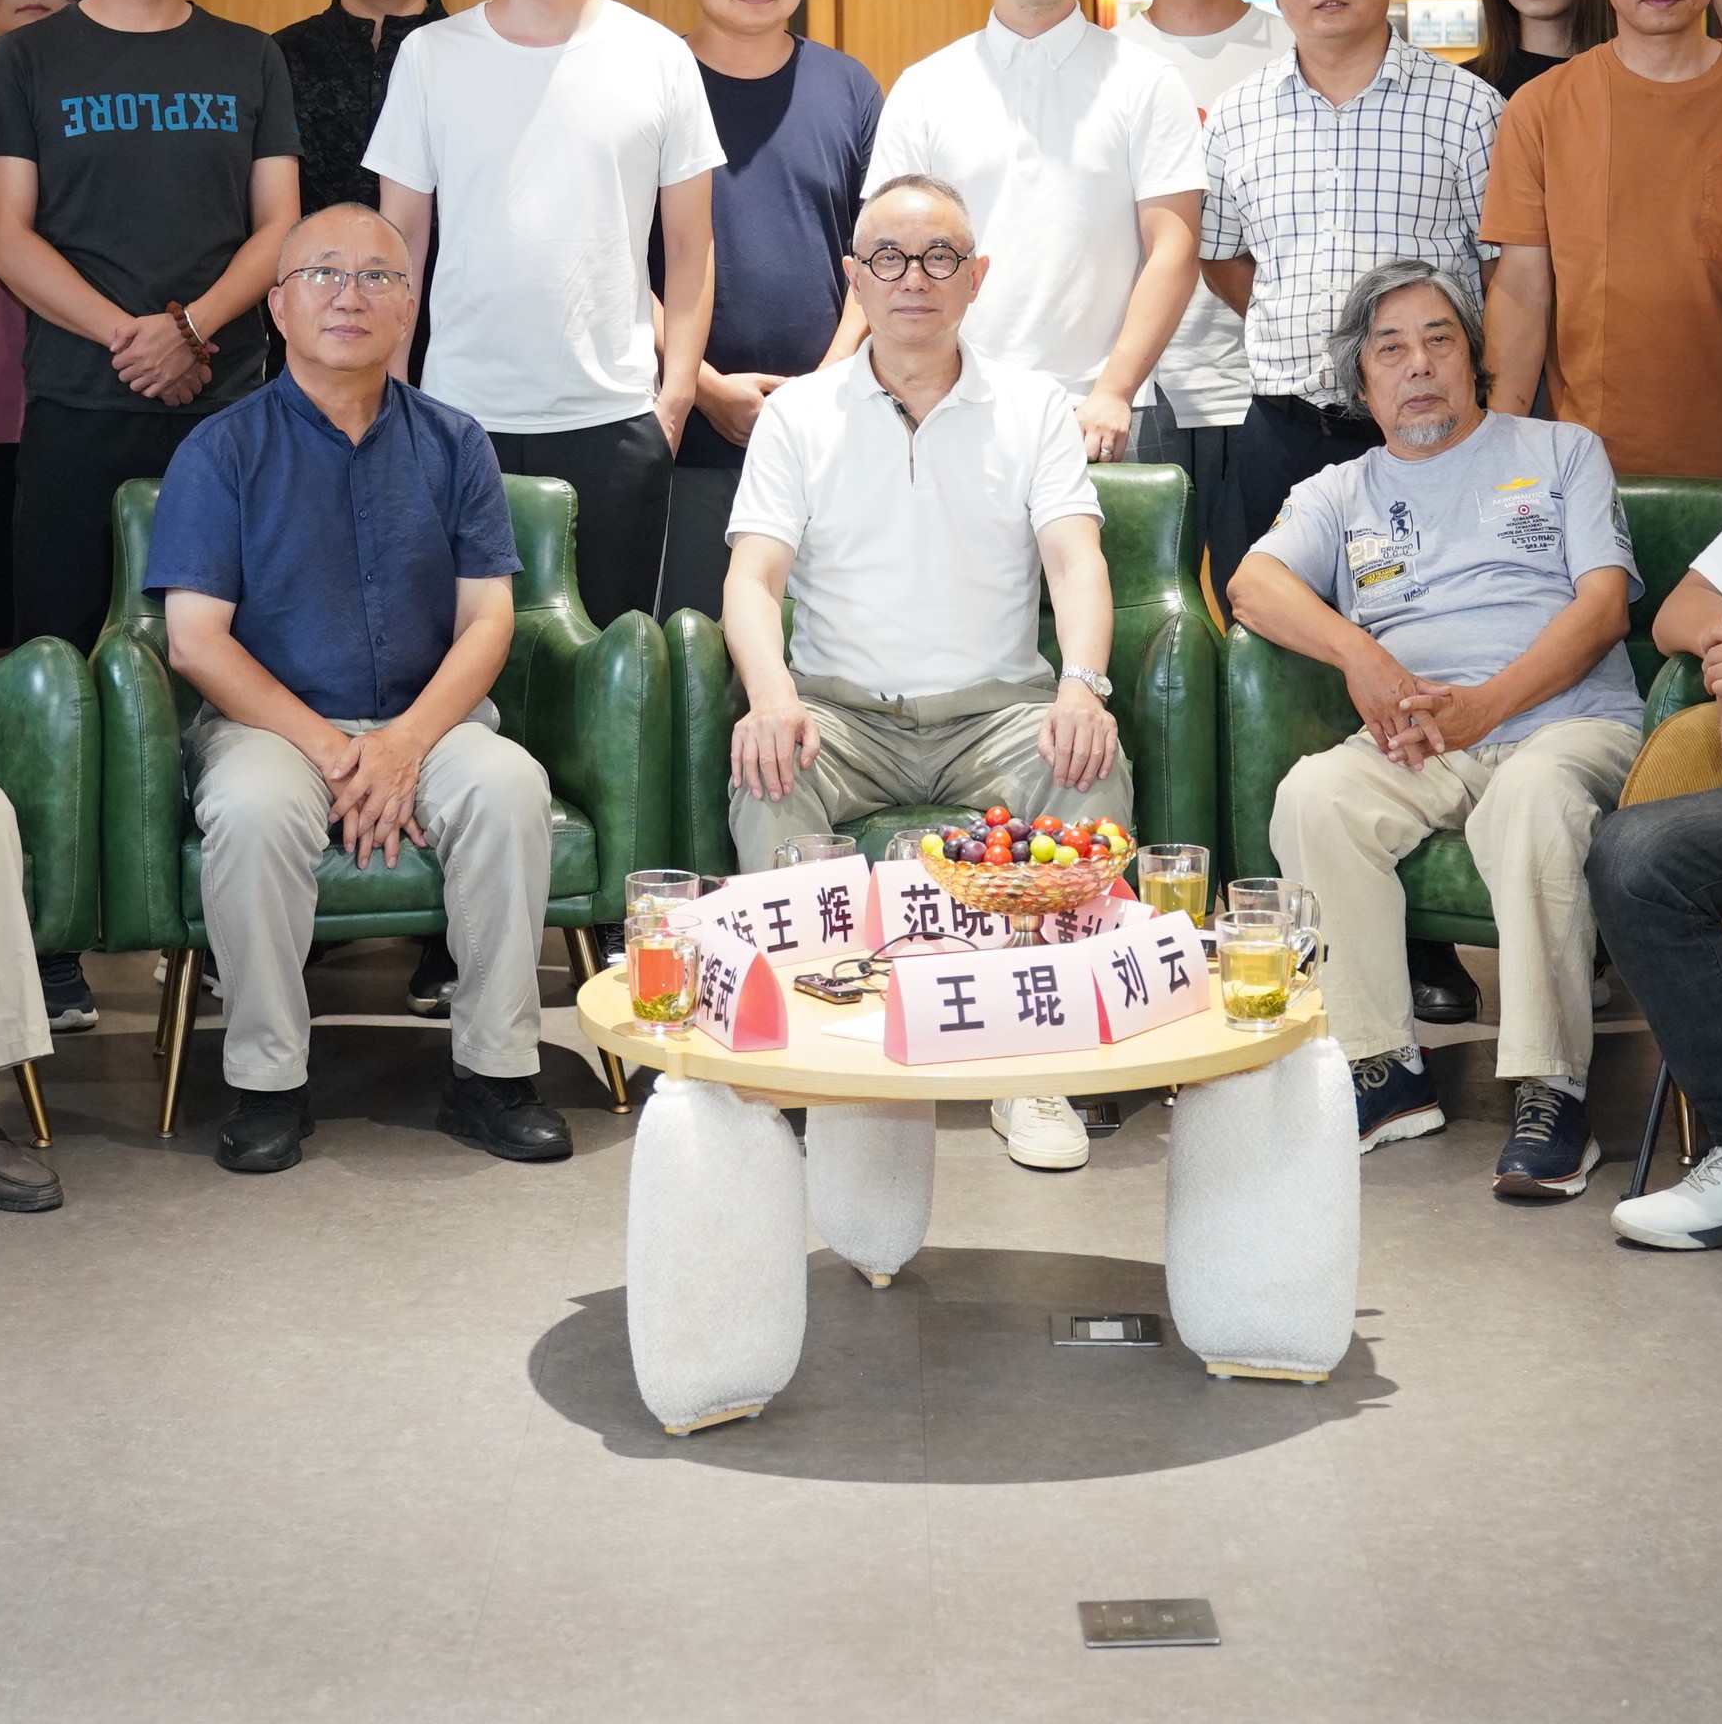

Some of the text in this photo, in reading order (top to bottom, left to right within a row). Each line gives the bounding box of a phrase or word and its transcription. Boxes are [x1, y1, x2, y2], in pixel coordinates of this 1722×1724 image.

[61, 92, 239, 138] EXPLORE
[762, 885, 854, 953] 王辉
[1055, 909, 1123, 944] 黄礼
[936, 965, 1065, 1033] 王琨
[1111, 936, 1191, 1010] 刘云
